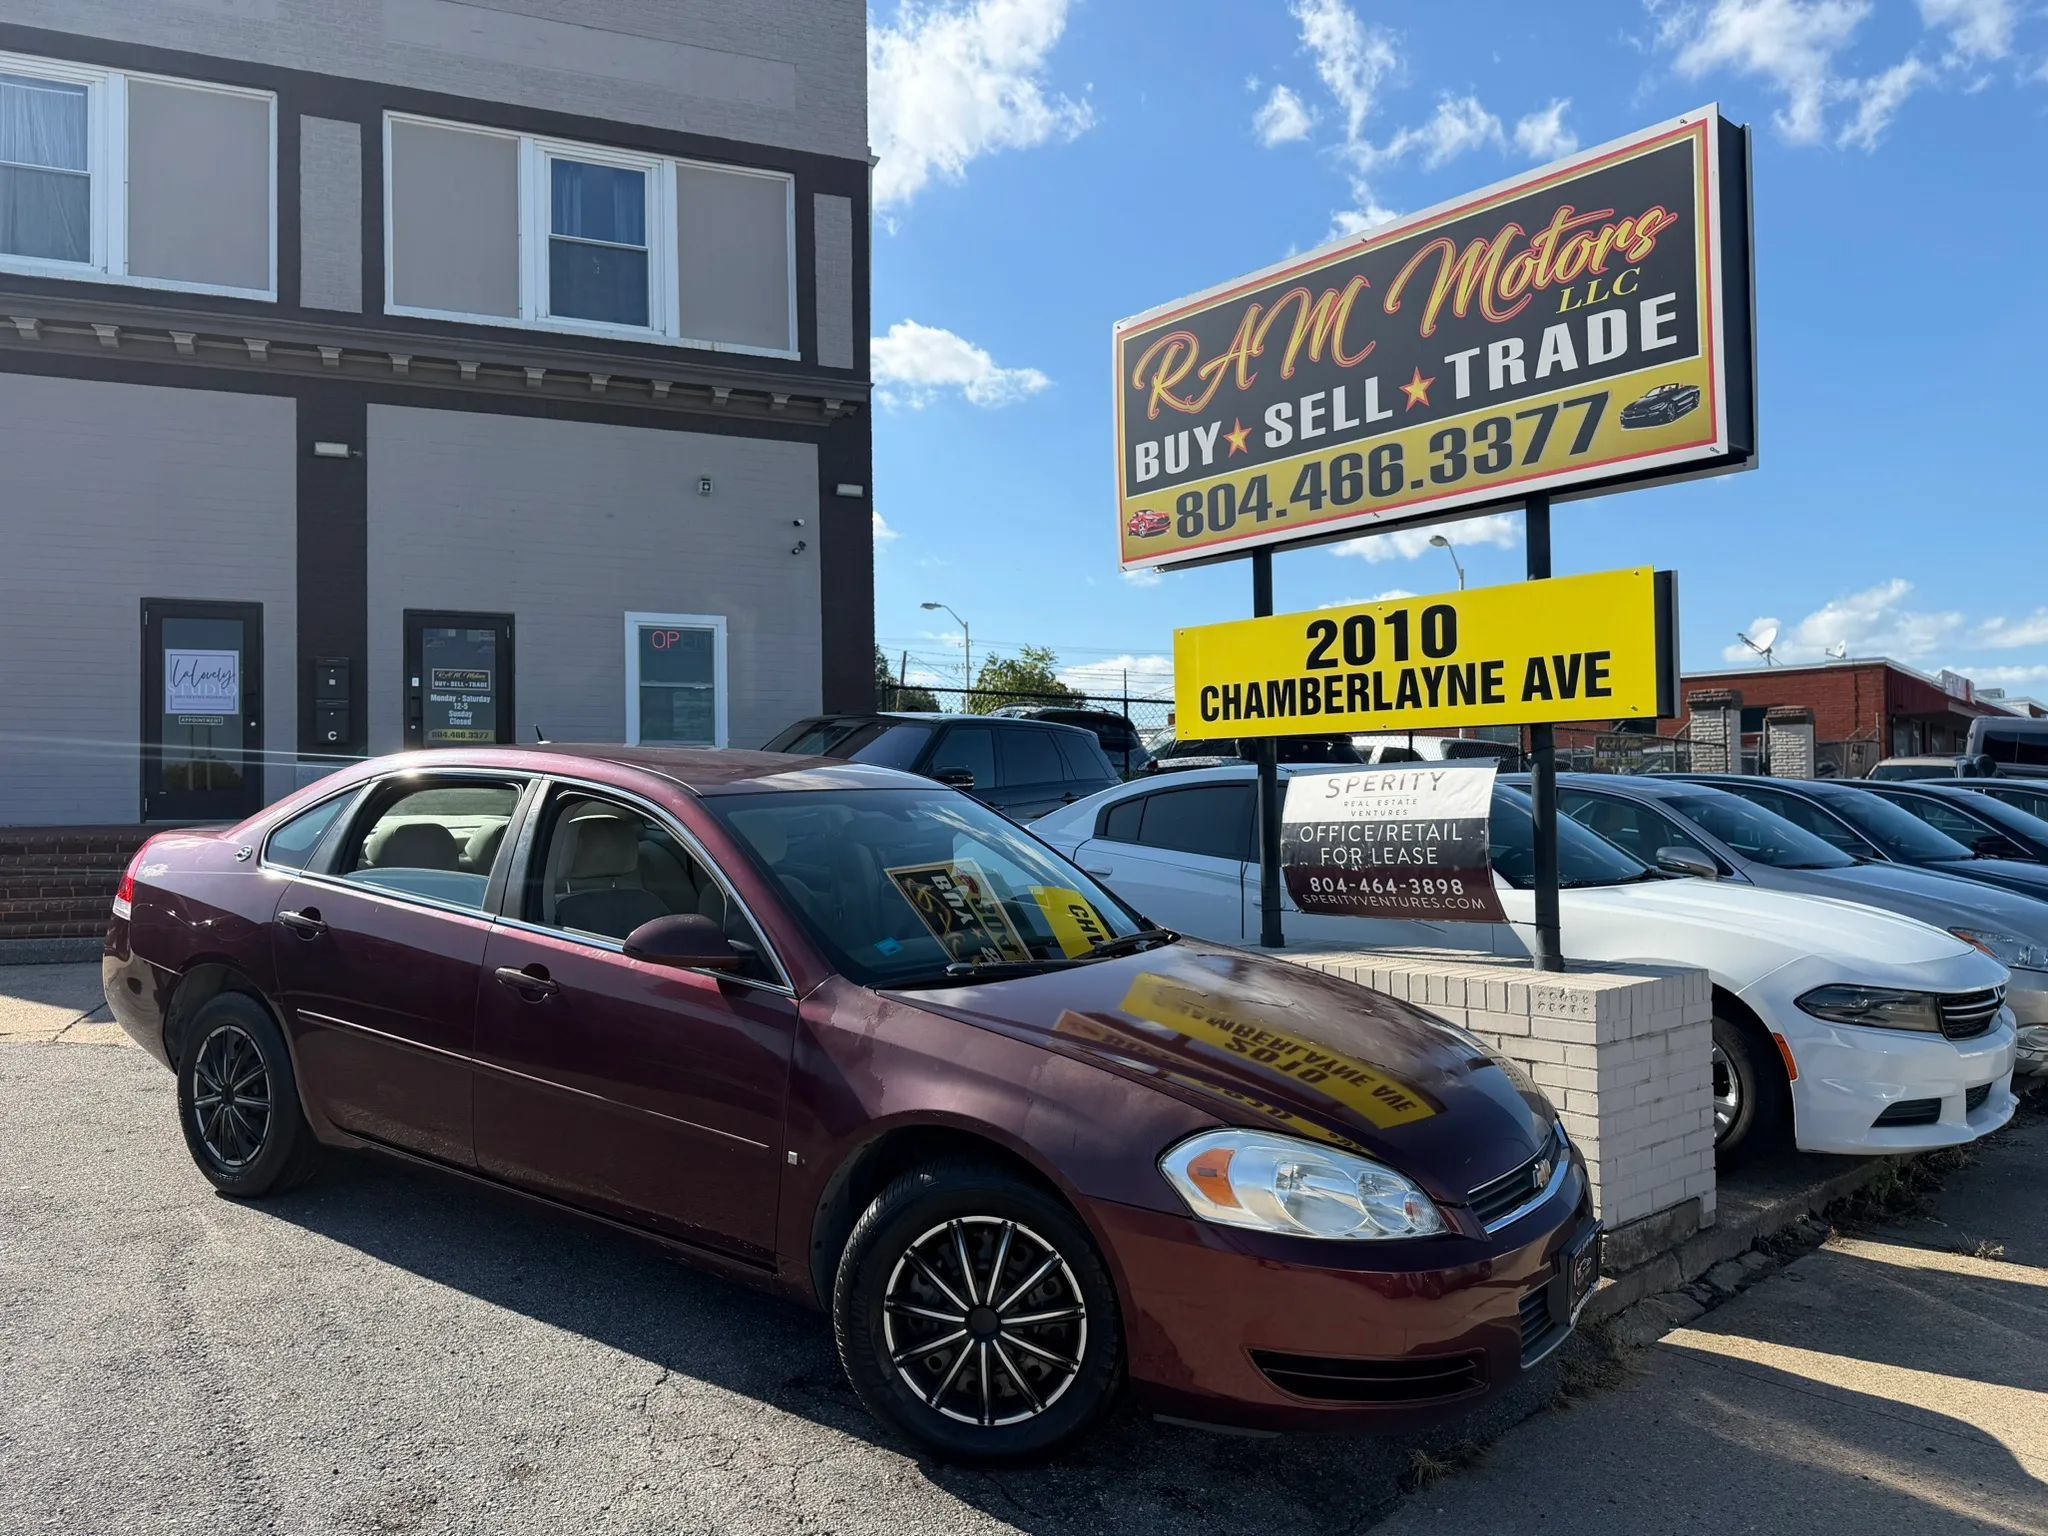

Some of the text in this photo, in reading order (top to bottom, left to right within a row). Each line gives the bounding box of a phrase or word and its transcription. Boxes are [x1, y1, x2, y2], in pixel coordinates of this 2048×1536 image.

[1556, 267, 1641, 314] LLC
[1132, 204, 1678, 420] RAM Motors
[1135, 292, 1678, 484] BUY SELL TRADE
[1175, 392, 1612, 539] 804.466.3377
[1305, 604, 1458, 671] 2010
[168, 683, 237, 696] STUDIO
[1200, 650, 1612, 722] CHAMBERLAYNE AVE
[430, 694, 456, 702] Monday
[462, 695, 491, 703] Saturday
[448, 710, 473, 718] Sunday
[327, 731, 337, 741] C
[1325, 771, 1447, 799] SPERITY
[1343, 798, 1418, 808] REAL ESTATE
[1350, 809, 1409, 817] VENTURES
[1299, 823, 1463, 843] OFFICE/RETAIL
[1321, 847, 1439, 866] FOR LEASE
[1309, 877, 1465, 896] 804-464-3898
[1302, 894, 1486, 911] SPERITYVENTURES.COM
